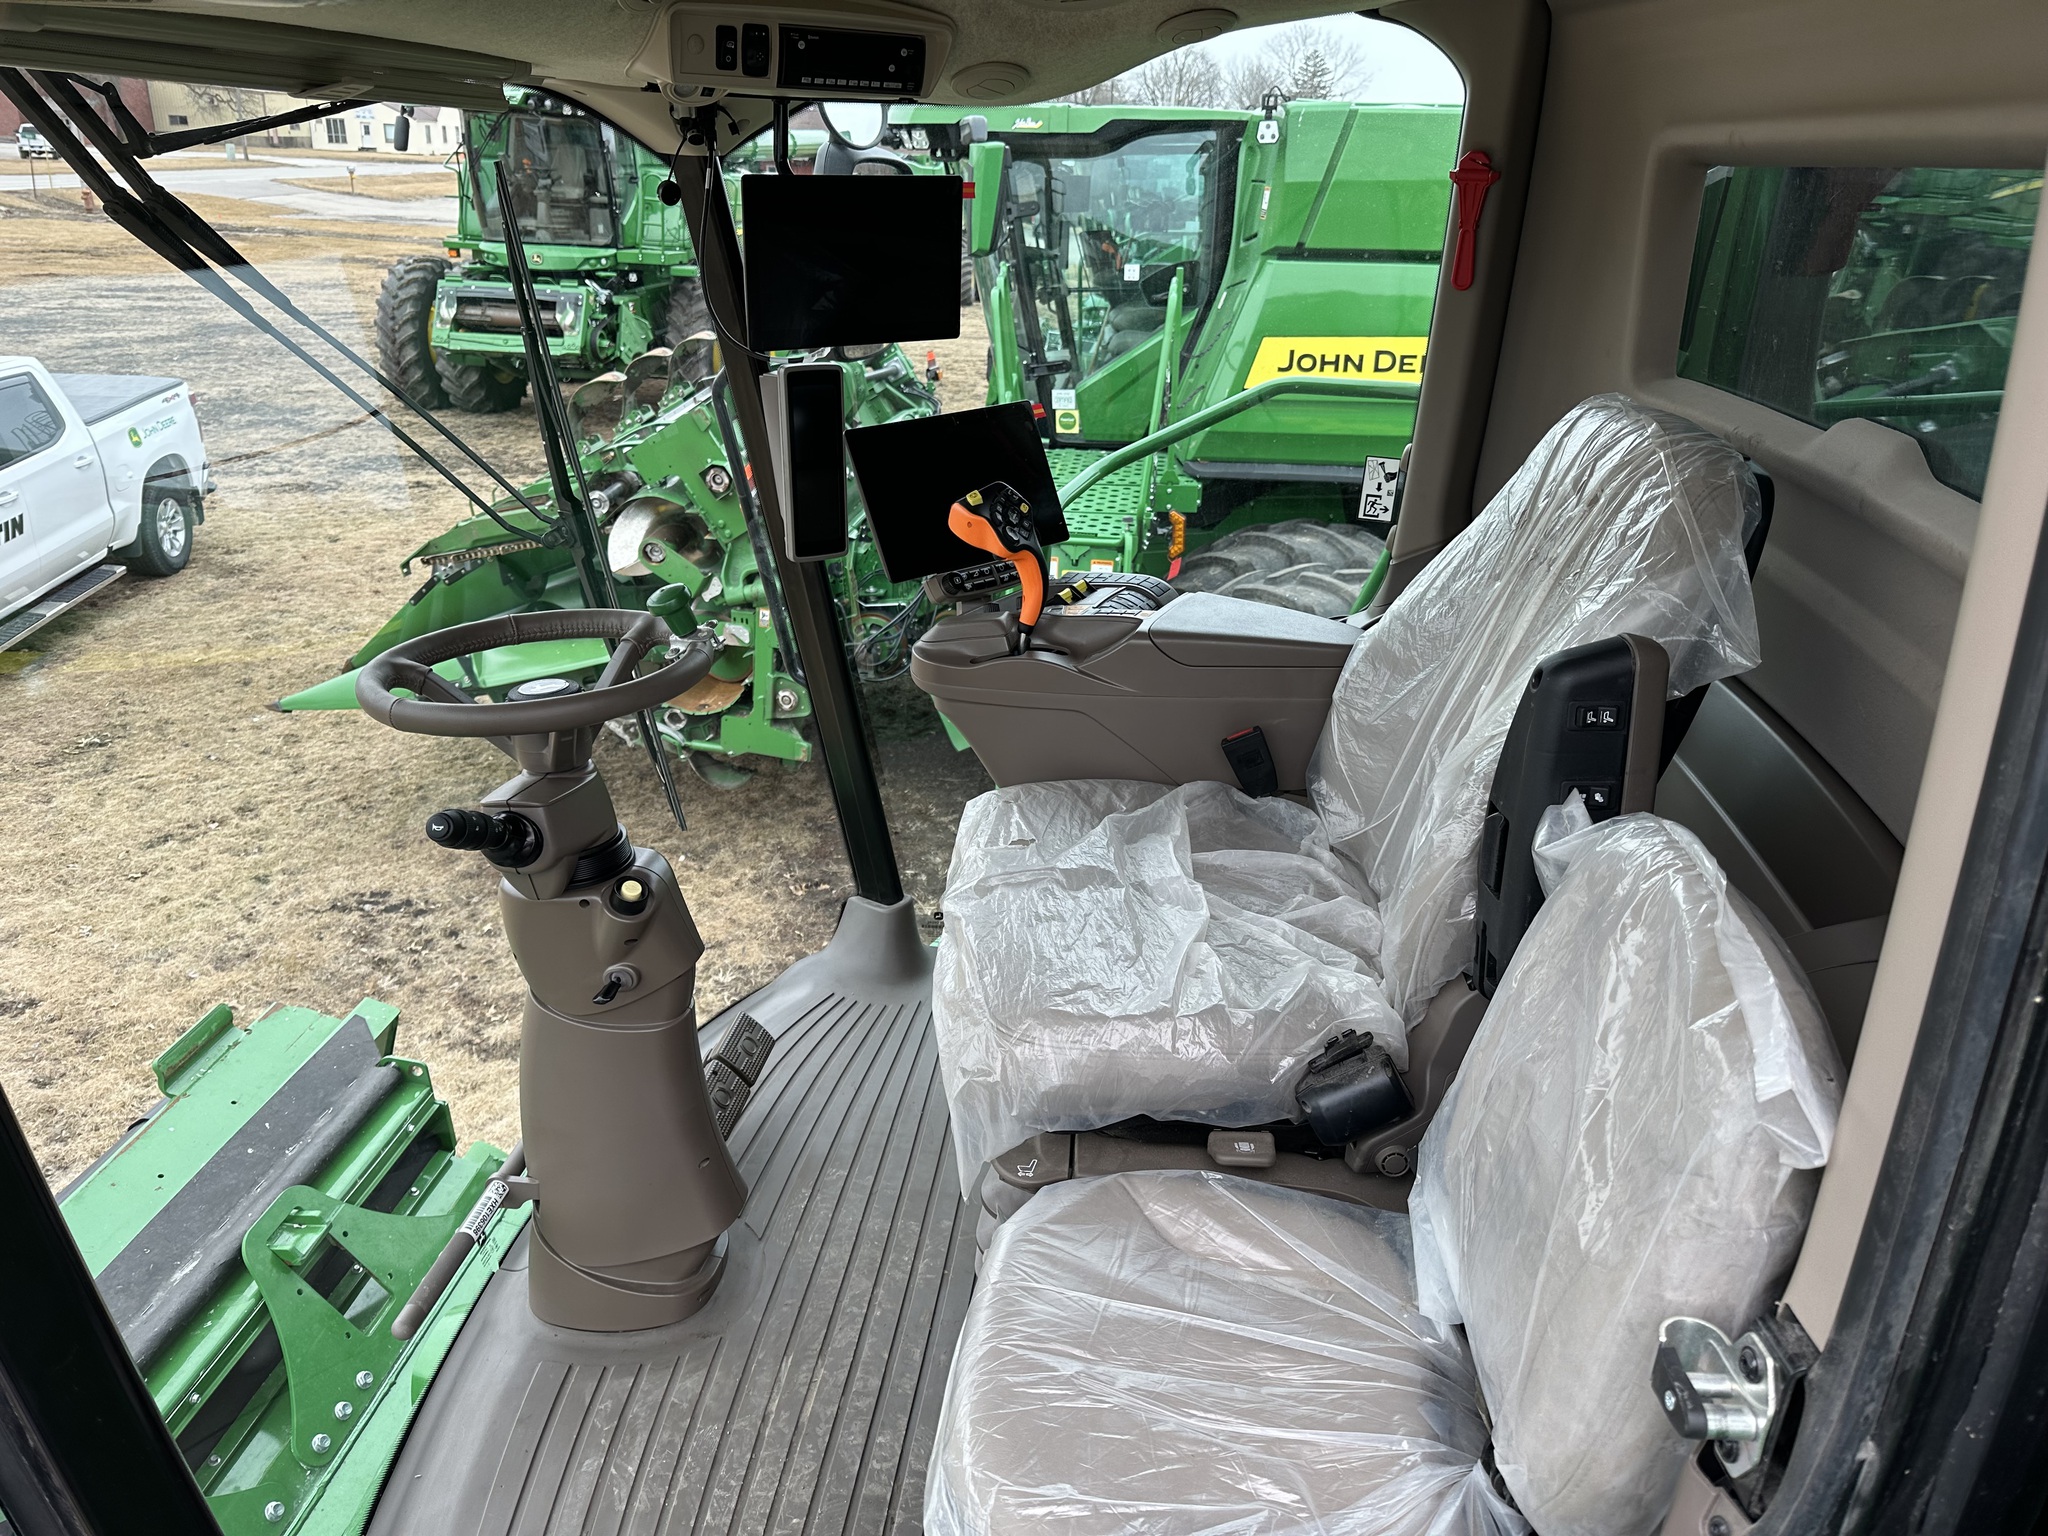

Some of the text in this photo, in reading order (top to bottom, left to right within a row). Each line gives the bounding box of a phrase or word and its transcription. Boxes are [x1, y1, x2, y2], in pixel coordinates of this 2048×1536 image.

[1277, 350, 1427, 373] JOHN DE
[143, 415, 177, 439] JOHN DEERE
